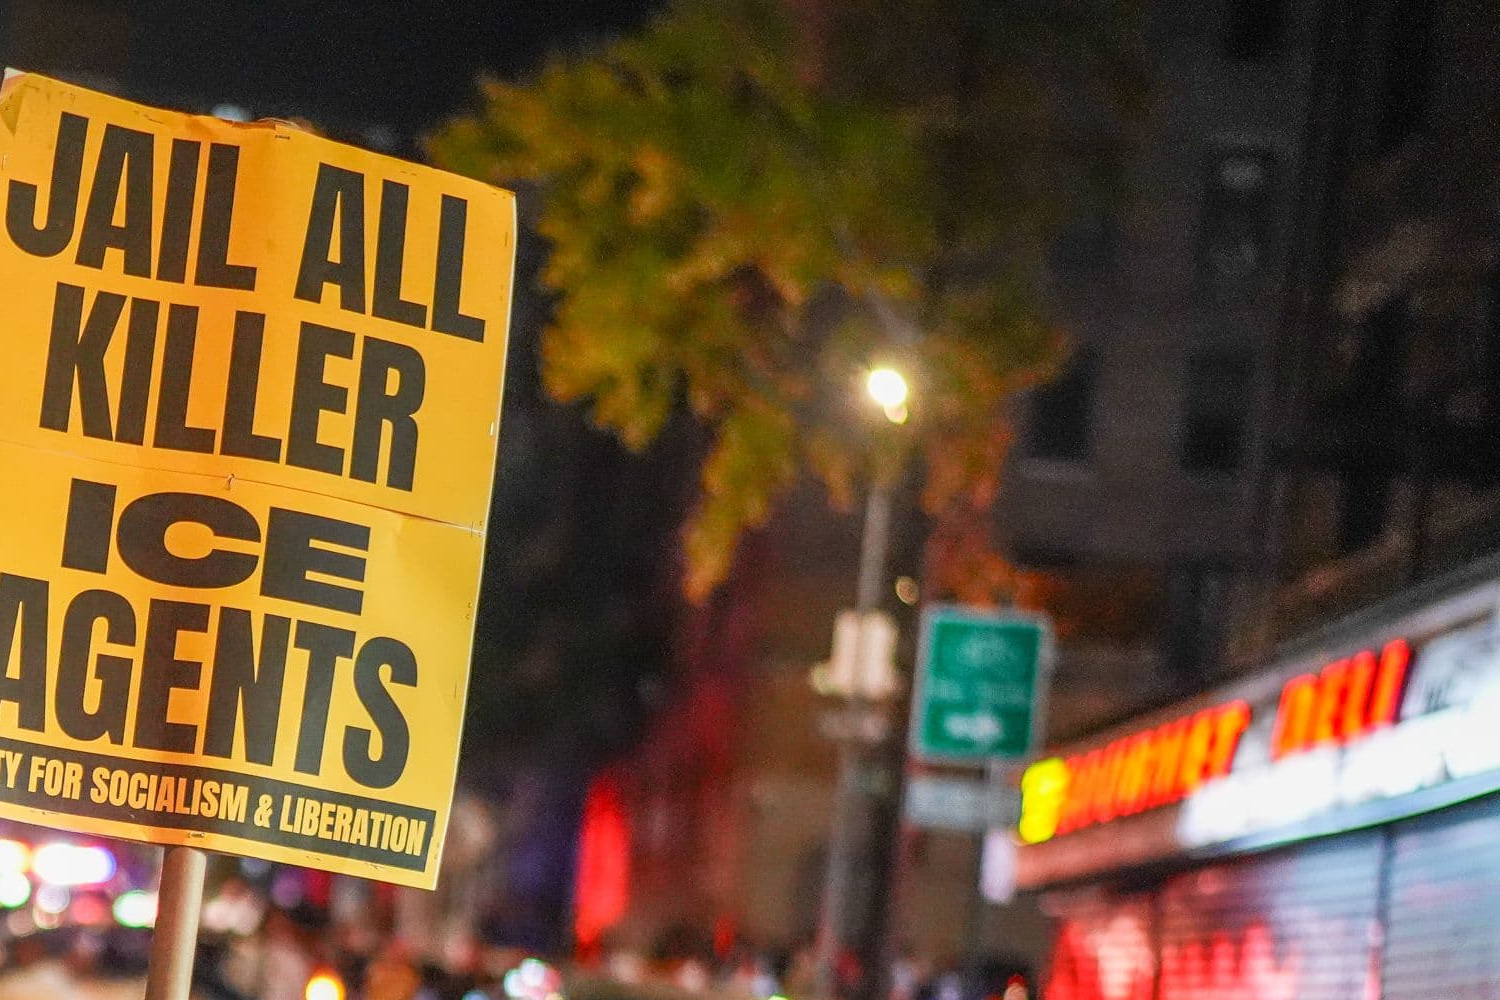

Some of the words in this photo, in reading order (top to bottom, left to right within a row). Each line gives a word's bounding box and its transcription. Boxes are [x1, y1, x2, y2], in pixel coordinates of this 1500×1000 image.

[6, 111, 257, 291] JAIL
[294, 162, 485, 343] ALL
[39, 282, 427, 490] KILLER
[60, 477, 371, 616] ICE
[28, 756, 83, 800] FOR
[90, 767, 249, 823] SOCIALISM
[253, 794, 272, 828] &
[280, 795, 426, 857] LIBERATION
